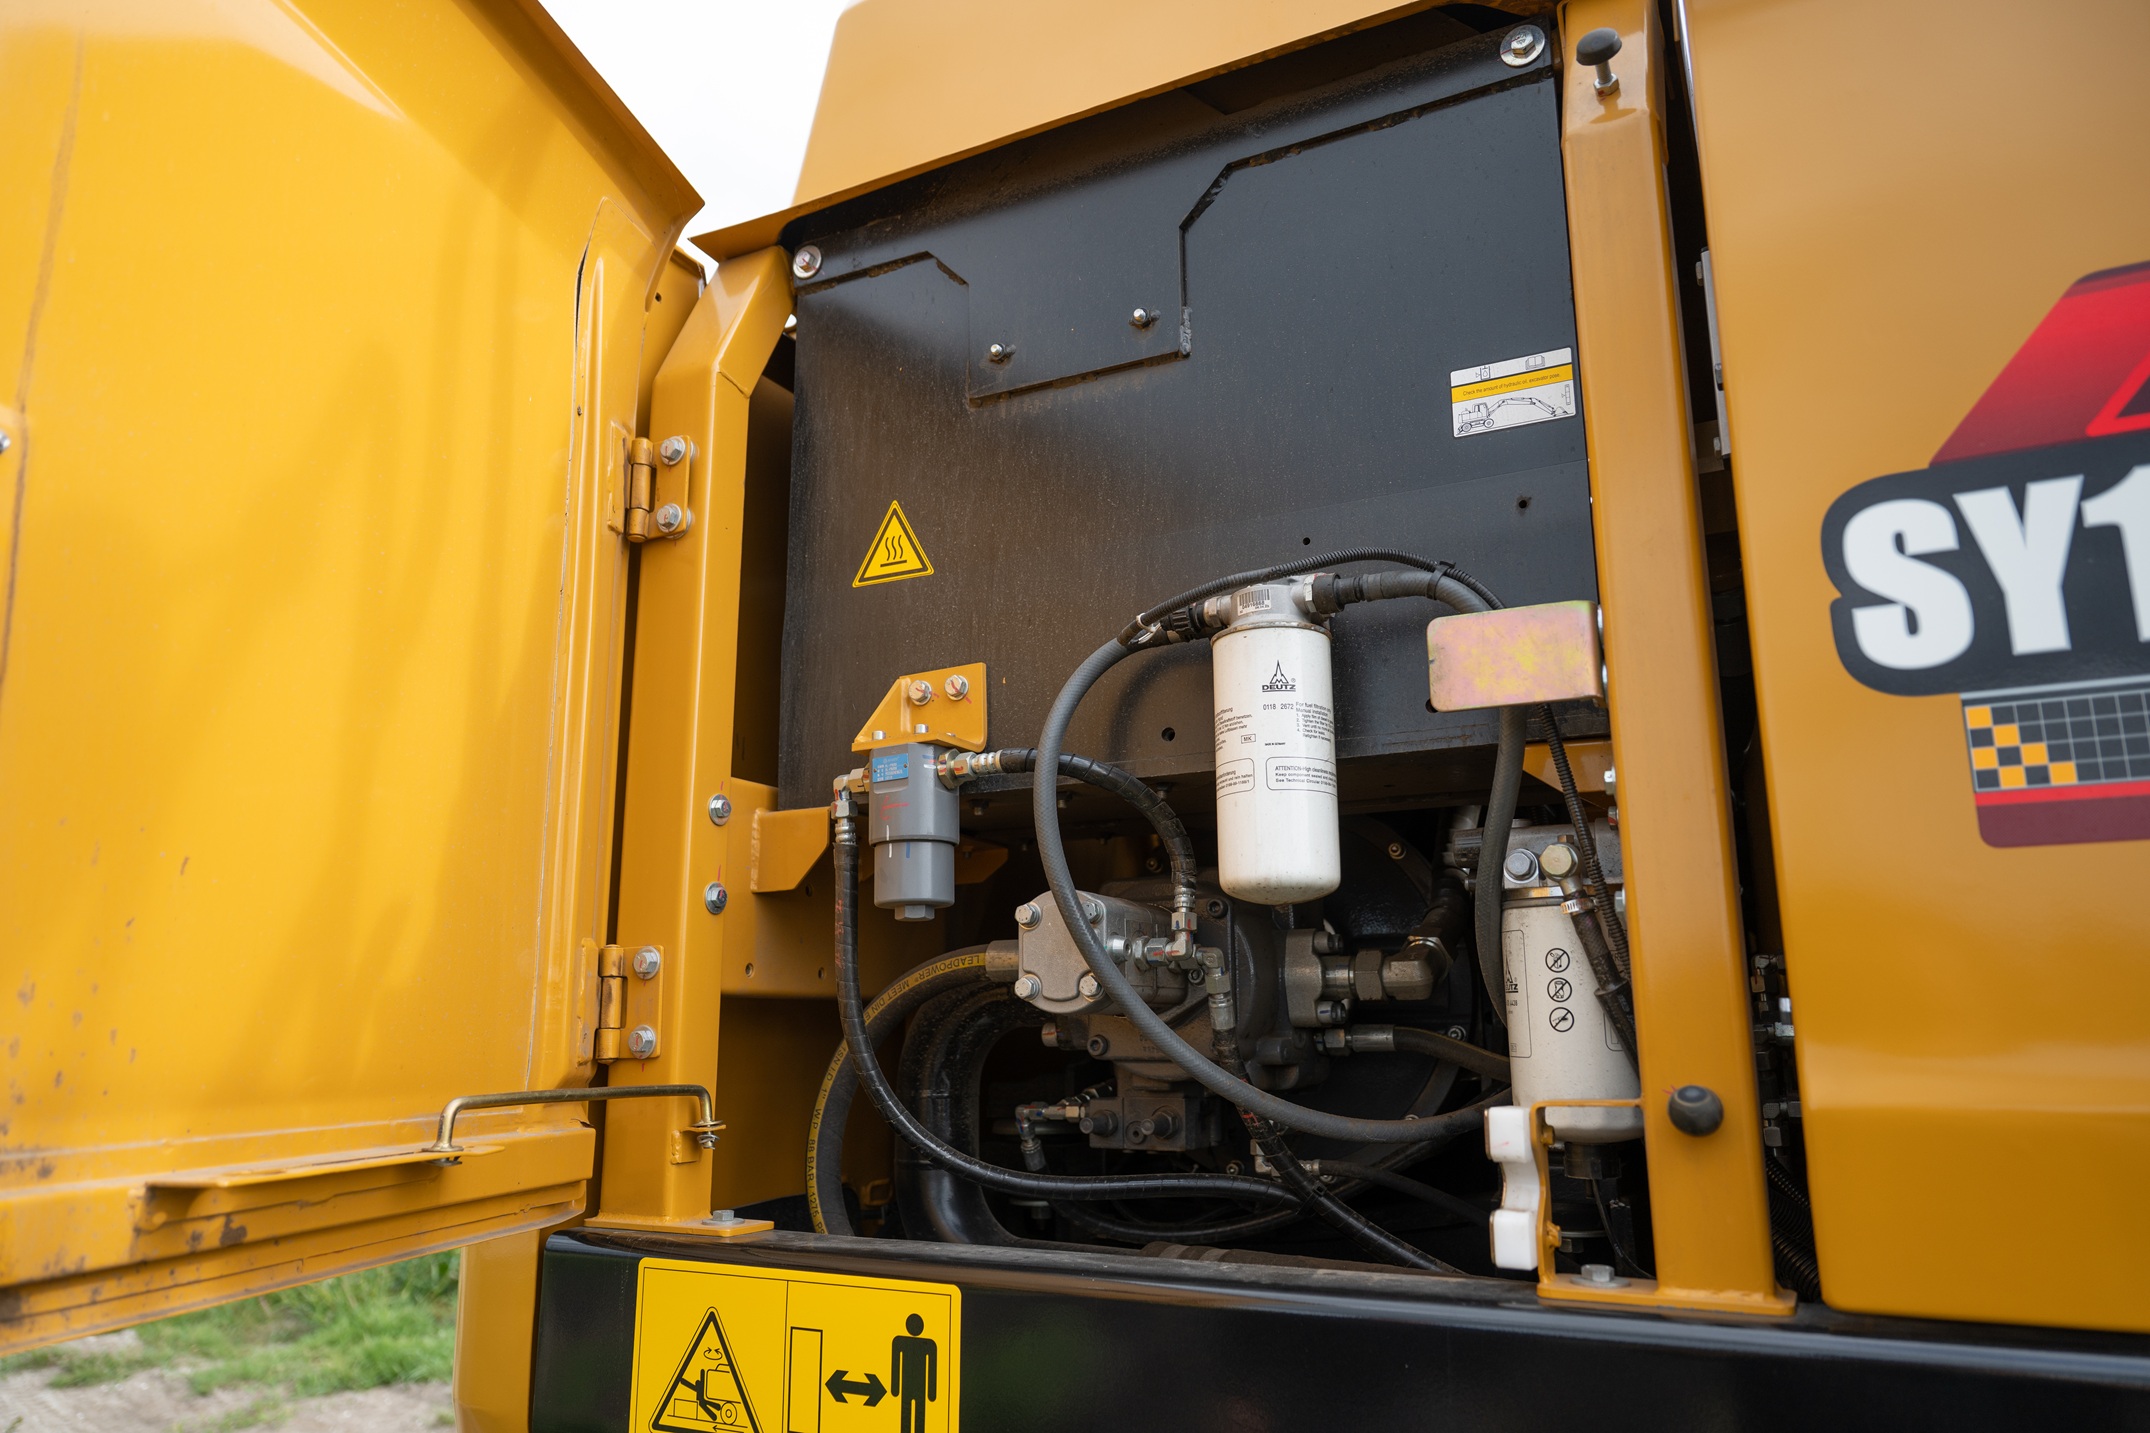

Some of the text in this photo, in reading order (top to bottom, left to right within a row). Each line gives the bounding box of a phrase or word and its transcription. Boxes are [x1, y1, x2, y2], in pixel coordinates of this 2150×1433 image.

[1503, 380, 1522, 388] hydraulic
[1529, 375, 1548, 383] excavator
[886, 979, 910, 1002] MEET
[872, 1000, 886, 1014] DIN
[808, 1139, 816, 1153] 88
[807, 1156, 815, 1182] BAR
[810, 1191, 820, 1218] 1275
